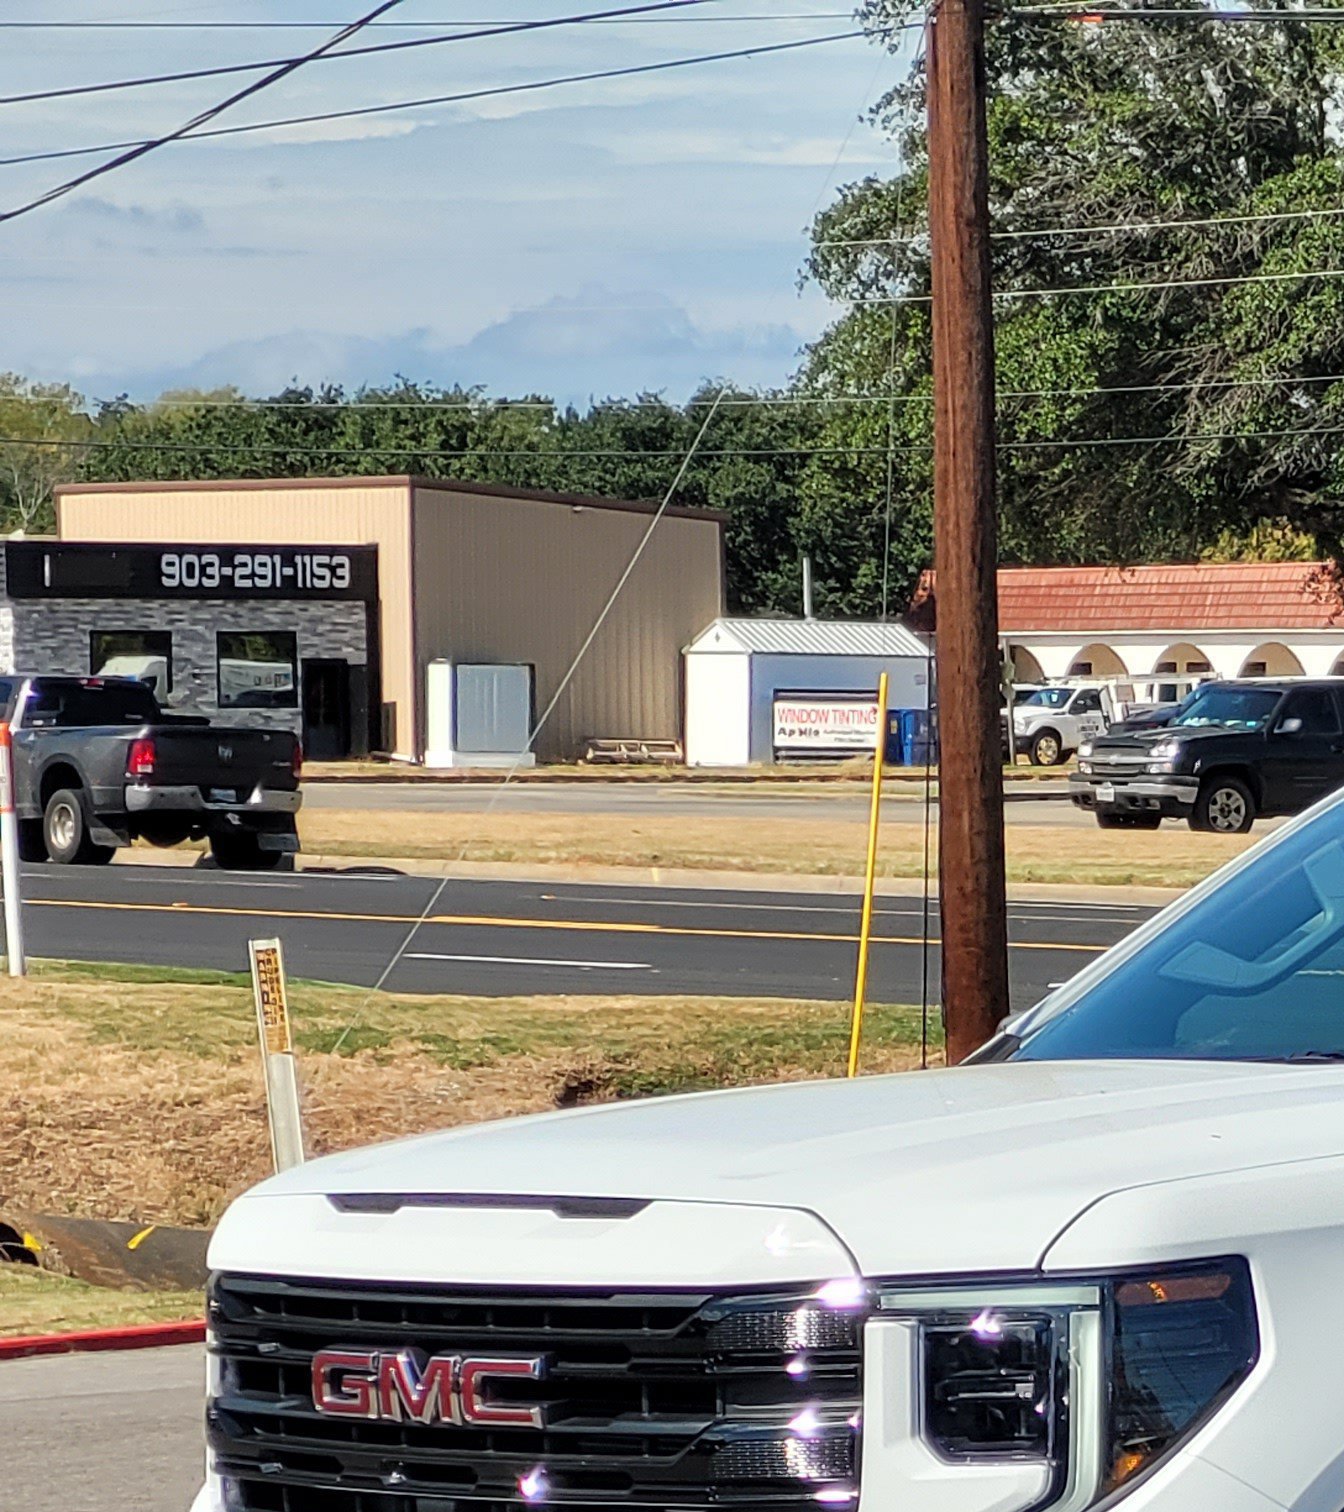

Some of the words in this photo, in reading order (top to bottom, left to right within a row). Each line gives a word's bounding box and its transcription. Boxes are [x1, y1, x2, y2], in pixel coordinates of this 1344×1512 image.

[161, 553, 350, 588] 903-291-1153
[778, 708, 830, 724] WINDOW
[831, 708, 877, 724] TINTING
[311, 1349, 546, 1430] GMC
